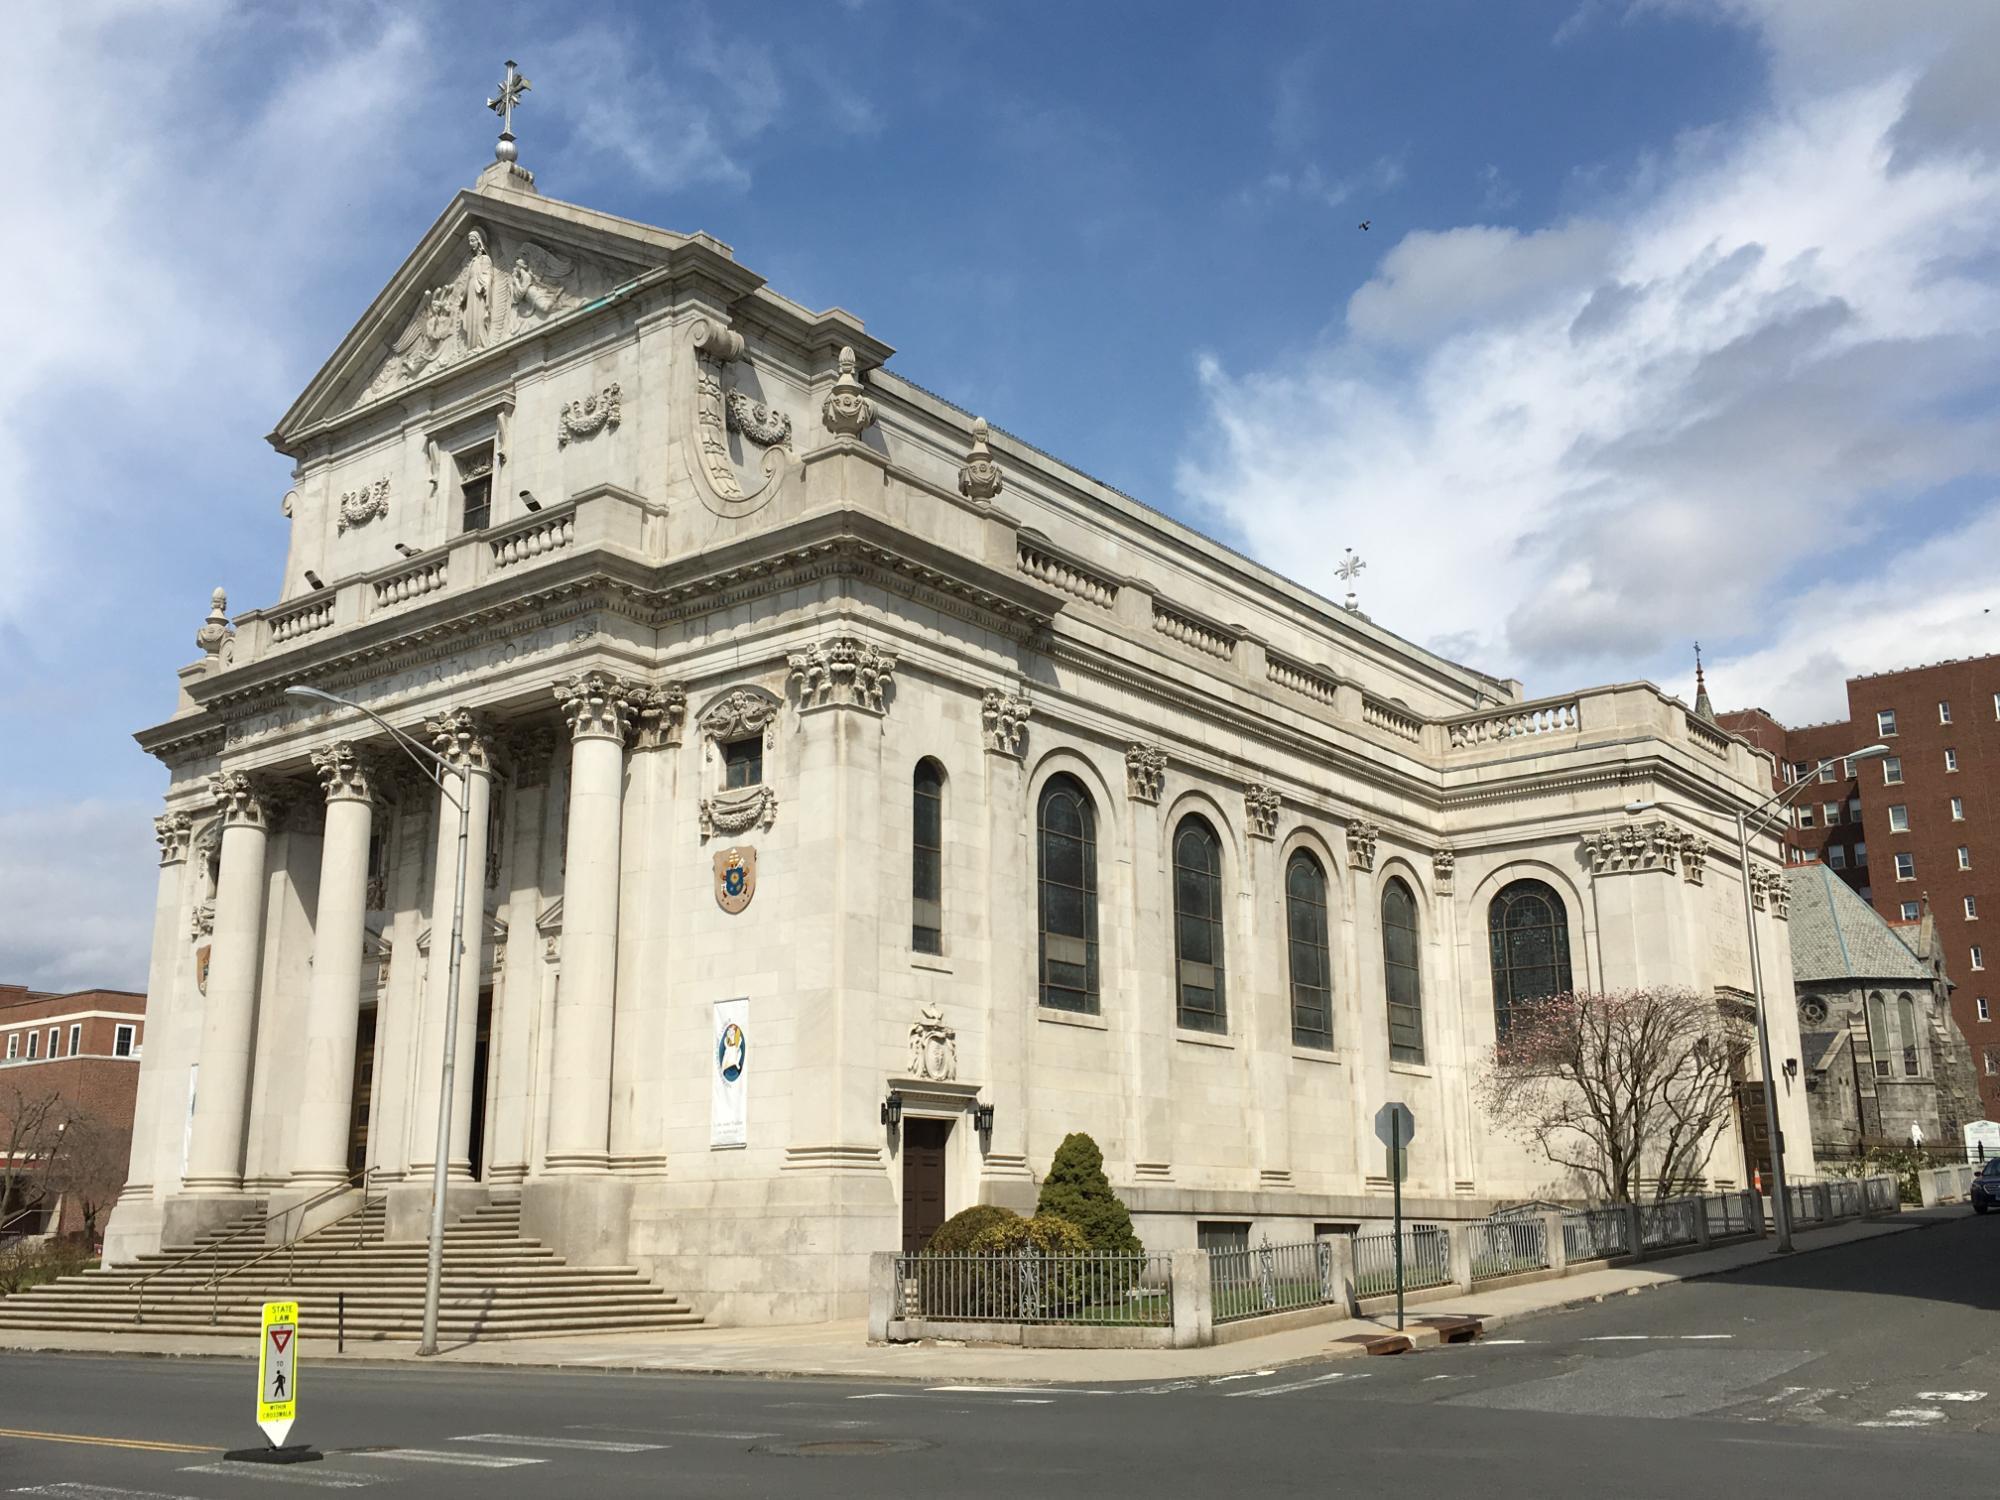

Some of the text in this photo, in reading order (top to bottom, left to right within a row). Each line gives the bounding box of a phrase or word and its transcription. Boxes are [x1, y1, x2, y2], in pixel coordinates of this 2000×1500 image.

[370, 679, 391, 704] ET
[406, 655, 475, 692] PORTA
[272, 1305, 293, 1313] STATE
